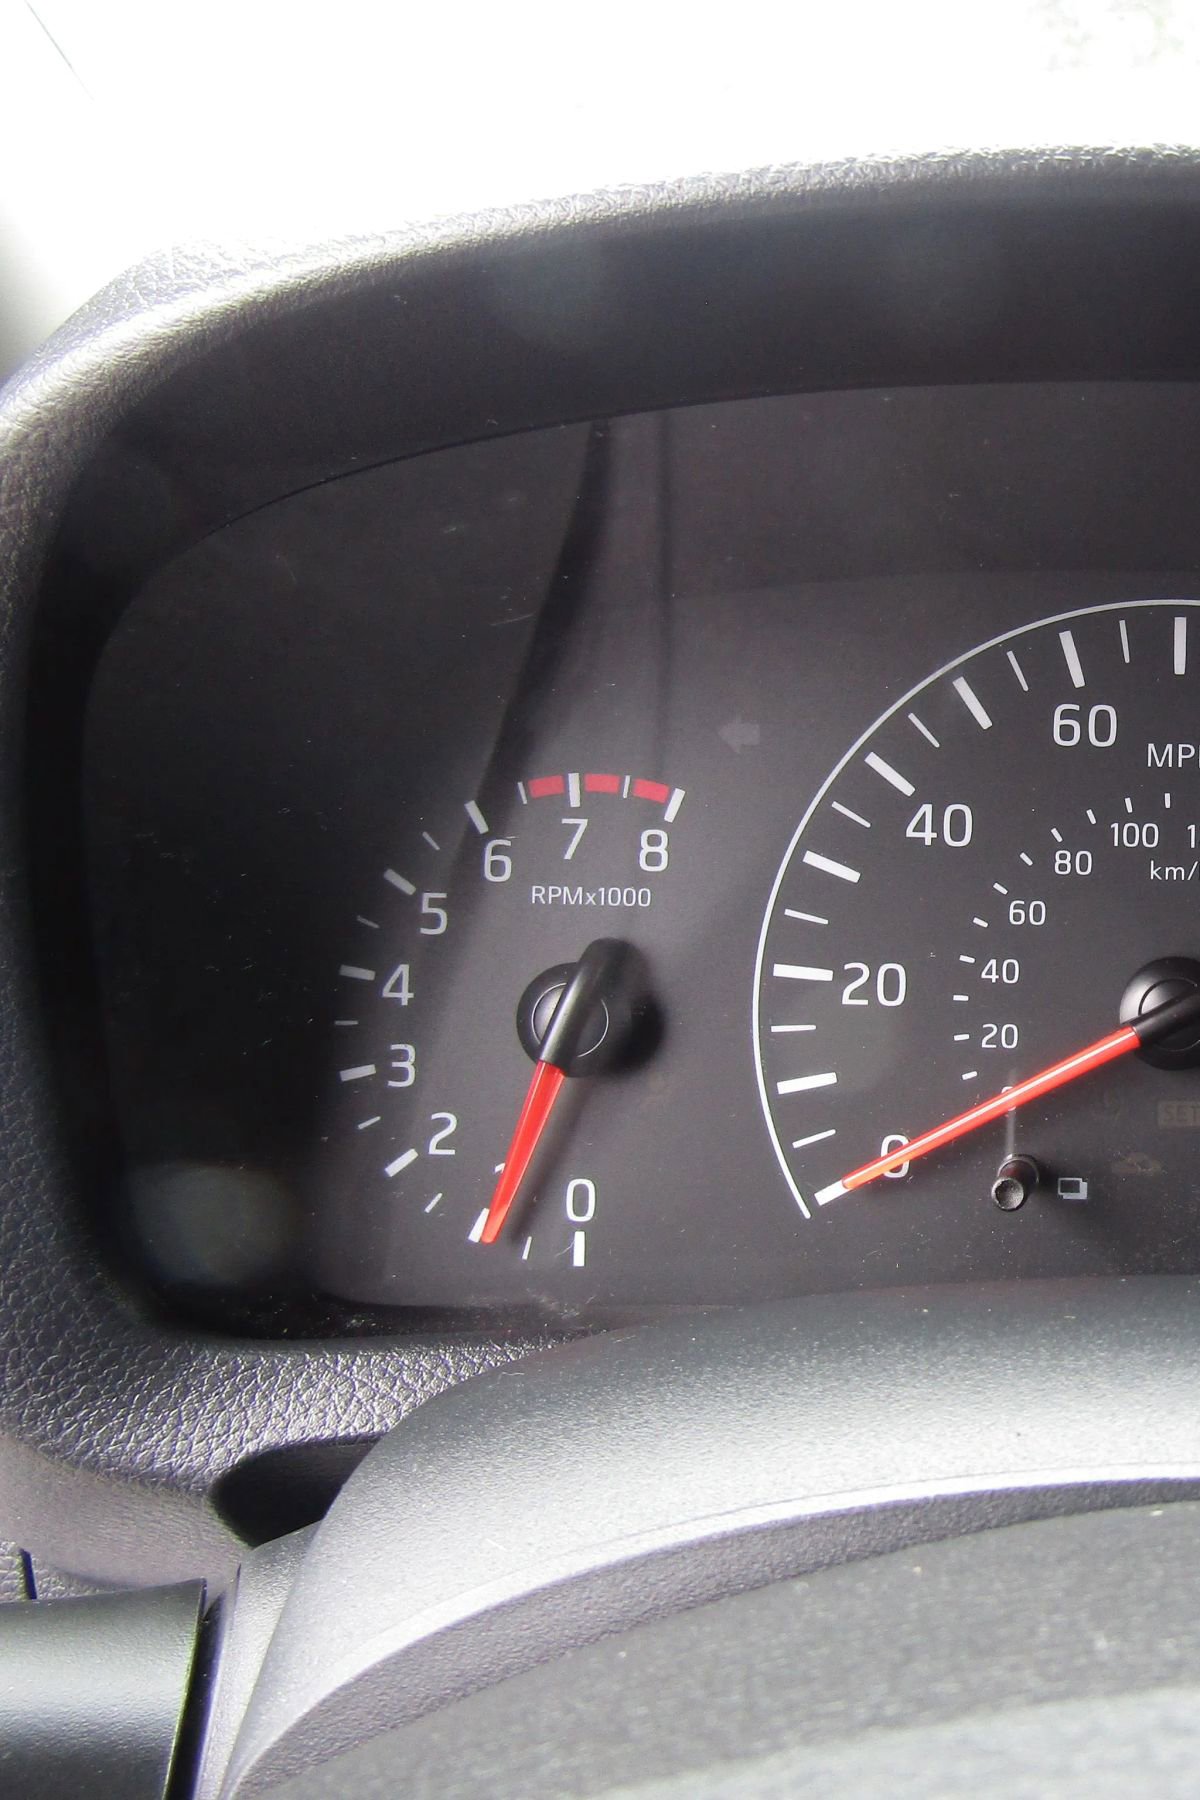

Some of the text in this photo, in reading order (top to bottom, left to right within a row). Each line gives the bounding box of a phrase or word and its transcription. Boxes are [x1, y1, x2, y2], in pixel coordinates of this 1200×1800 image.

[1054, 704, 1116, 747] 60
[562, 819, 588, 859] 7
[906, 804, 972, 846] 40
[1111, 823, 1158, 847] 100
[485, 840, 511, 882] 6
[639, 830, 668, 871] 8
[1055, 850, 1092, 875] 80
[420, 893, 447, 934] 5
[532, 886, 650, 906] RPMx1000
[1010, 901, 1045, 925] 60
[383, 964, 414, 1005] 4
[842, 963, 906, 1006] 20
[981, 959, 1019, 983] 40
[982, 1024, 1018, 1048] 20
[388, 1044, 415, 1087] 3
[429, 1112, 457, 1155] 2
[566, 1179, 595, 1222] 0
